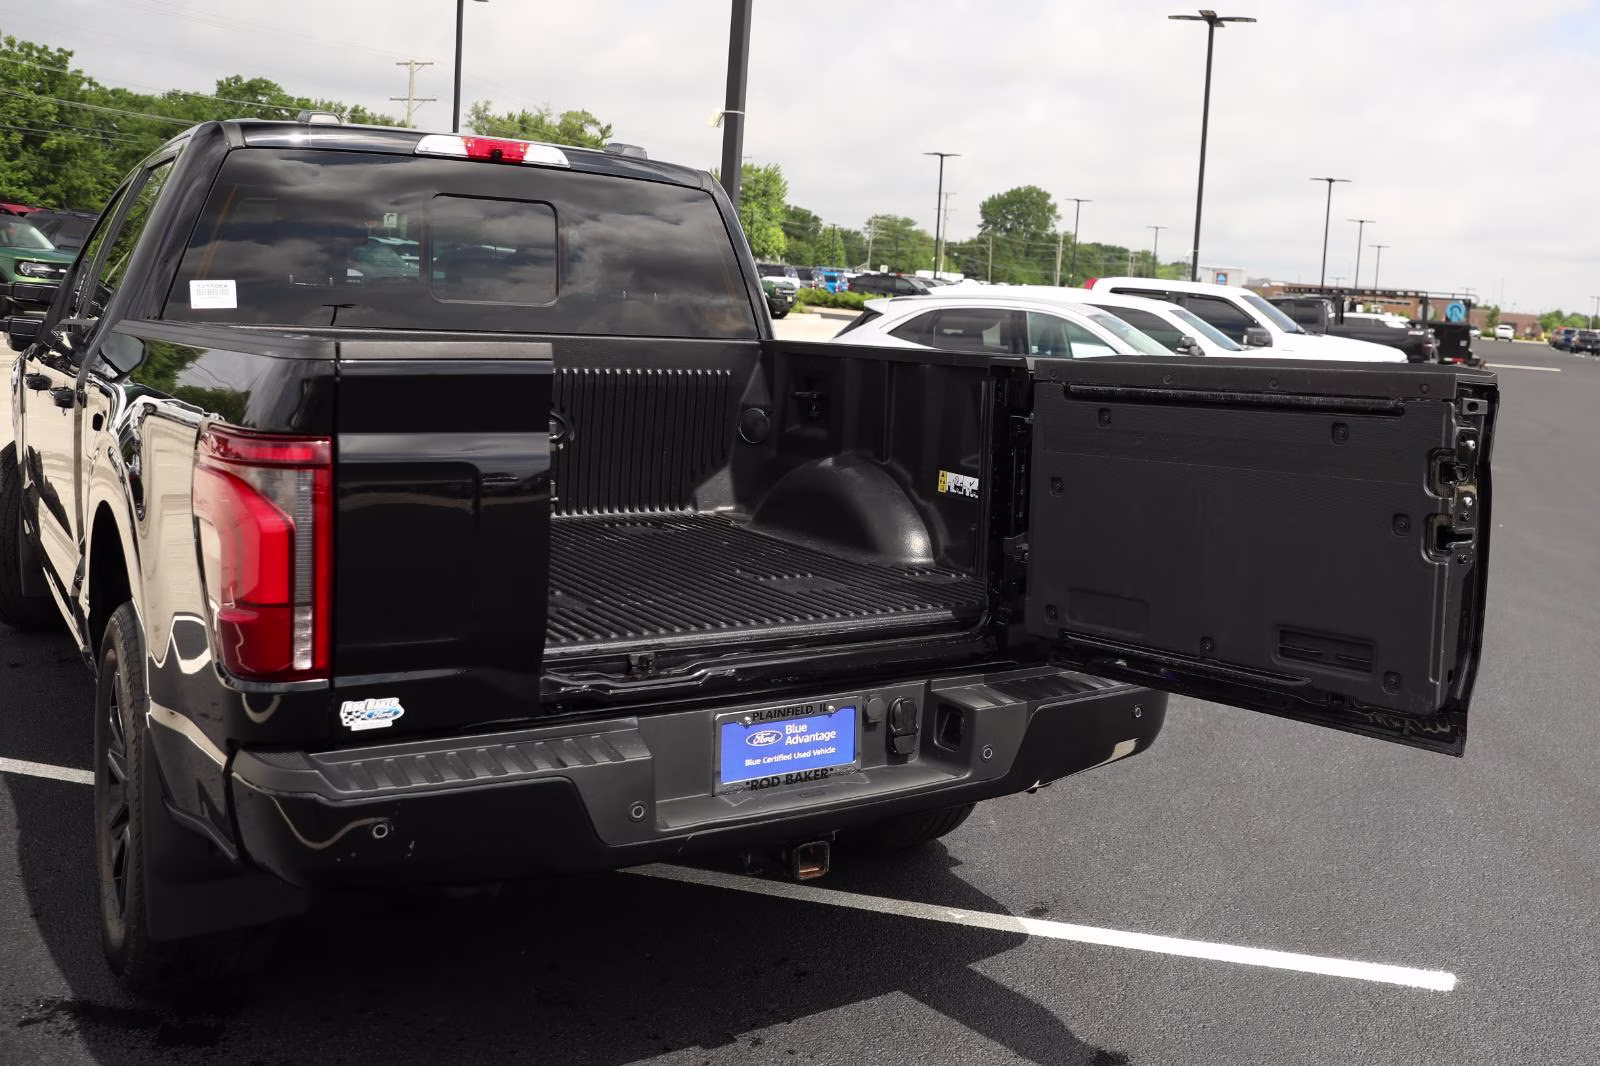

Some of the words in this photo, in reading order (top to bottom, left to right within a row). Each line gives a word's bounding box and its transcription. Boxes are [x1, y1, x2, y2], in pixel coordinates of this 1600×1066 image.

[752, 705, 815, 721] PLAINFIELD,
[819, 703, 827, 713] IL
[785, 723, 807, 735] Blue
[752, 733, 776, 744] Ford
[785, 730, 837, 746] Advantage
[745, 757, 761, 767] Blue
[763, 753, 792, 764] Certified
[793, 749, 811, 760] Used
[813, 746, 836, 757] Vehicle
[749, 776, 781, 791] ROD
[785, 768, 829, 785] BAKER
